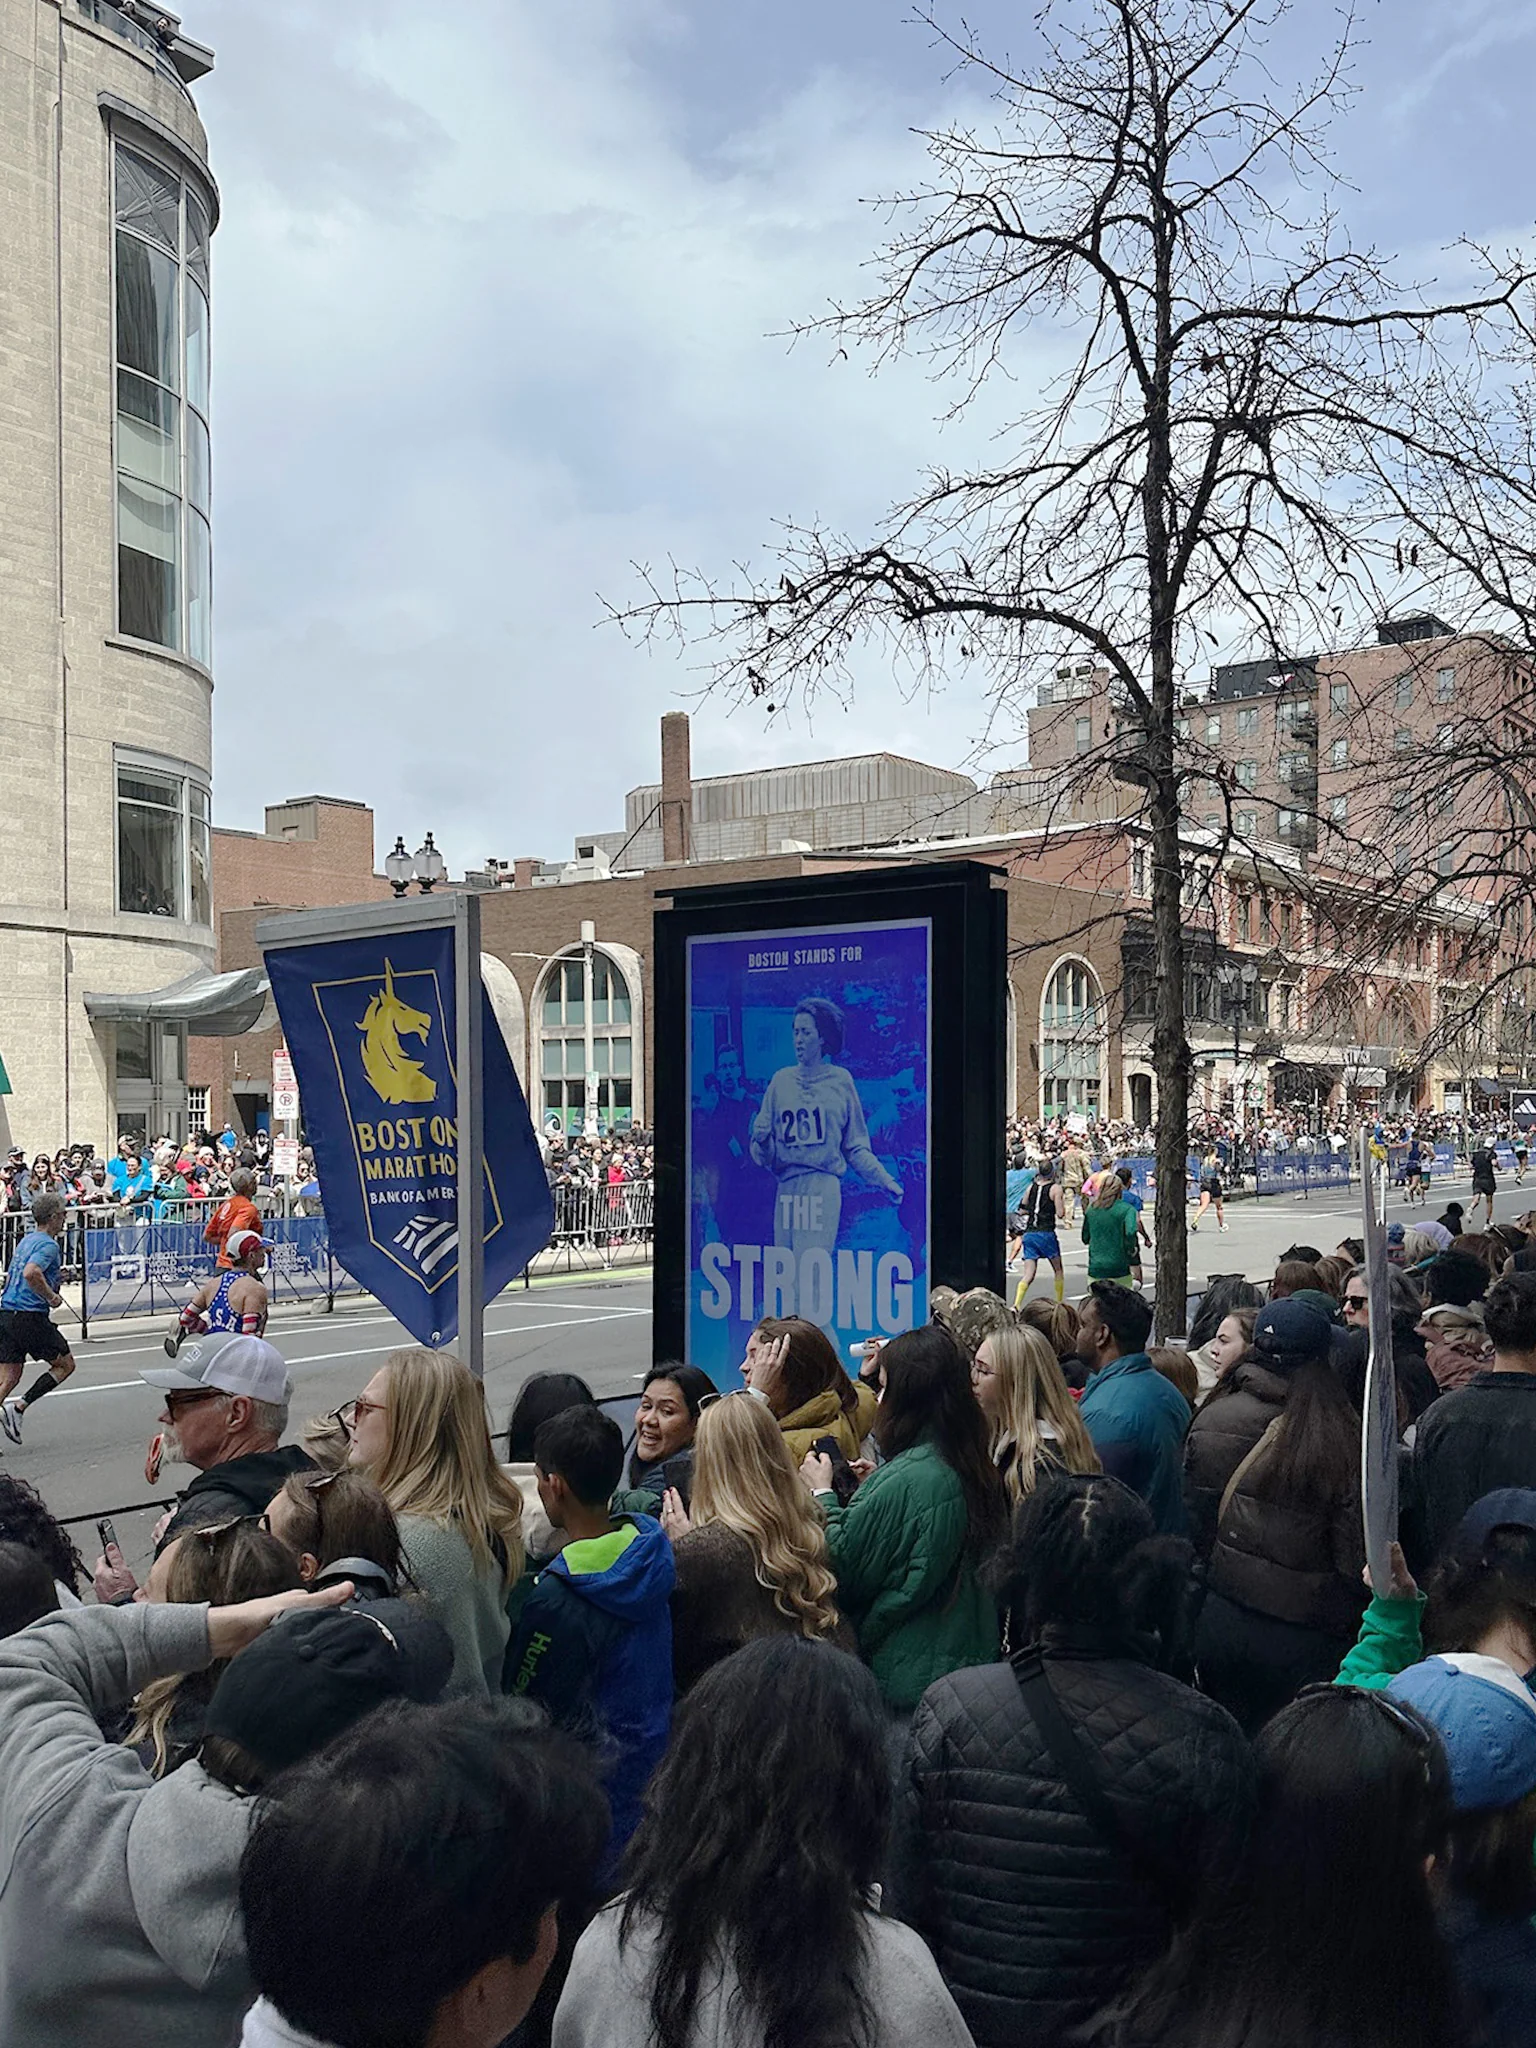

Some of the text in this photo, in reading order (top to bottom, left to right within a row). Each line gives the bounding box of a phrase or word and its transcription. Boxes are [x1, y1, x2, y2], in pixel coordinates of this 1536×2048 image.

[748, 946, 862, 968] BOSTON STANDS FOR
[782, 1106, 822, 1143] 261
[364, 1152, 457, 1181] MARATHO
[780, 1195, 823, 1230] THE
[700, 1242, 913, 1335] STRONG
